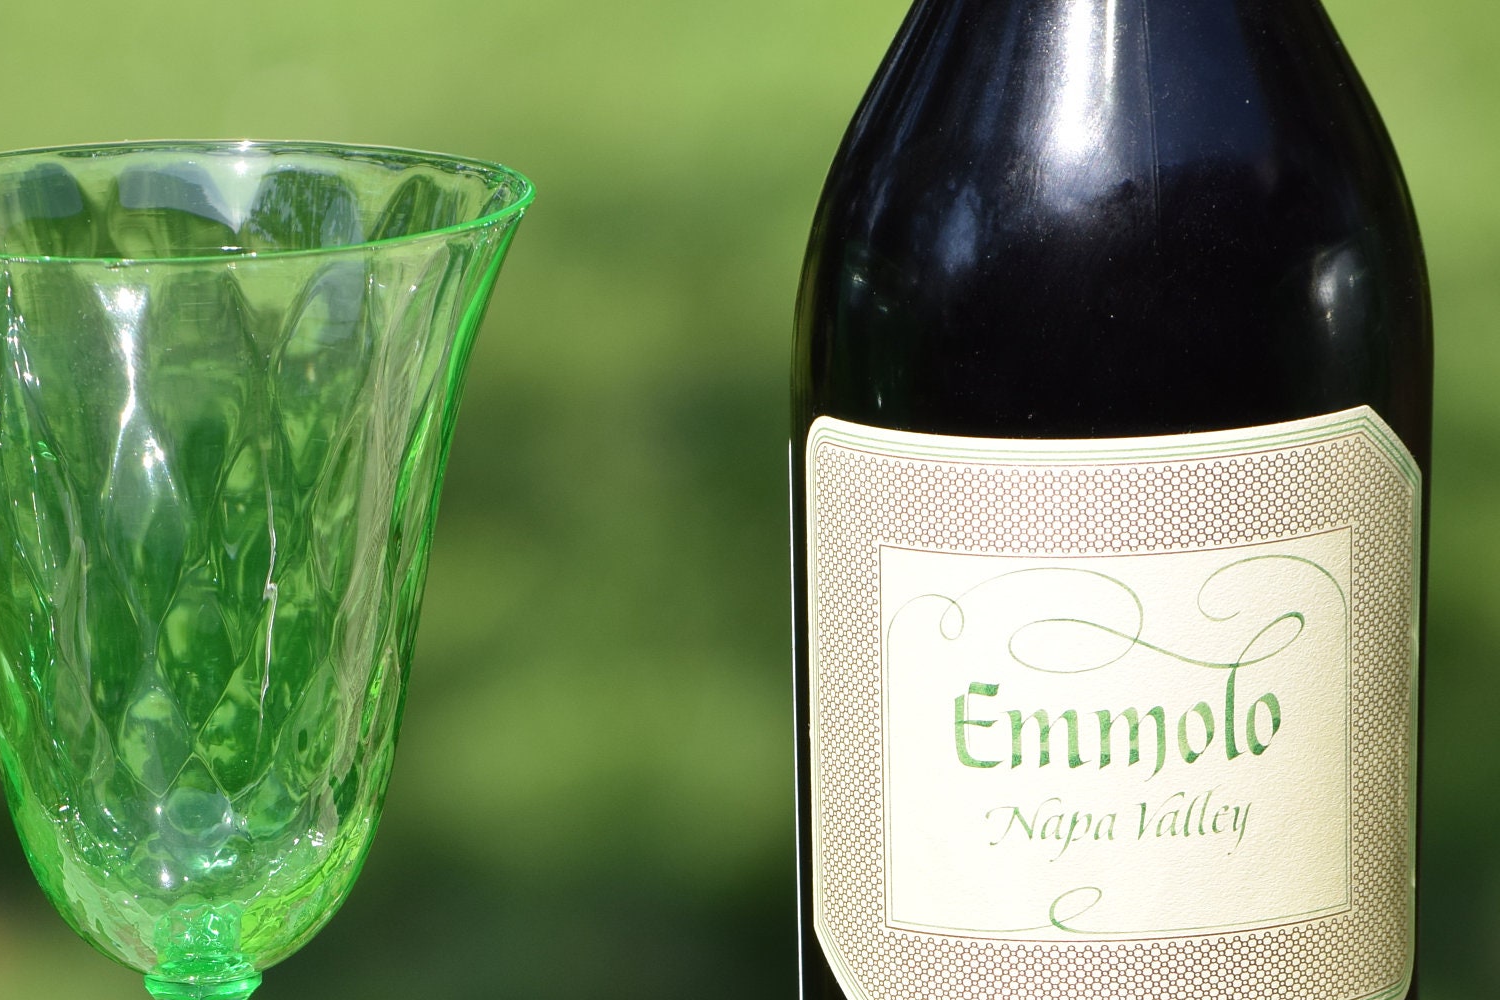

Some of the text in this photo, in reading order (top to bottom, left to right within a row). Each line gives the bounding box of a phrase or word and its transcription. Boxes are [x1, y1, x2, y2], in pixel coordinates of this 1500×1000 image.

[954, 666, 1282, 782] Emmolo
[985, 784, 1253, 862] Napa Valley
